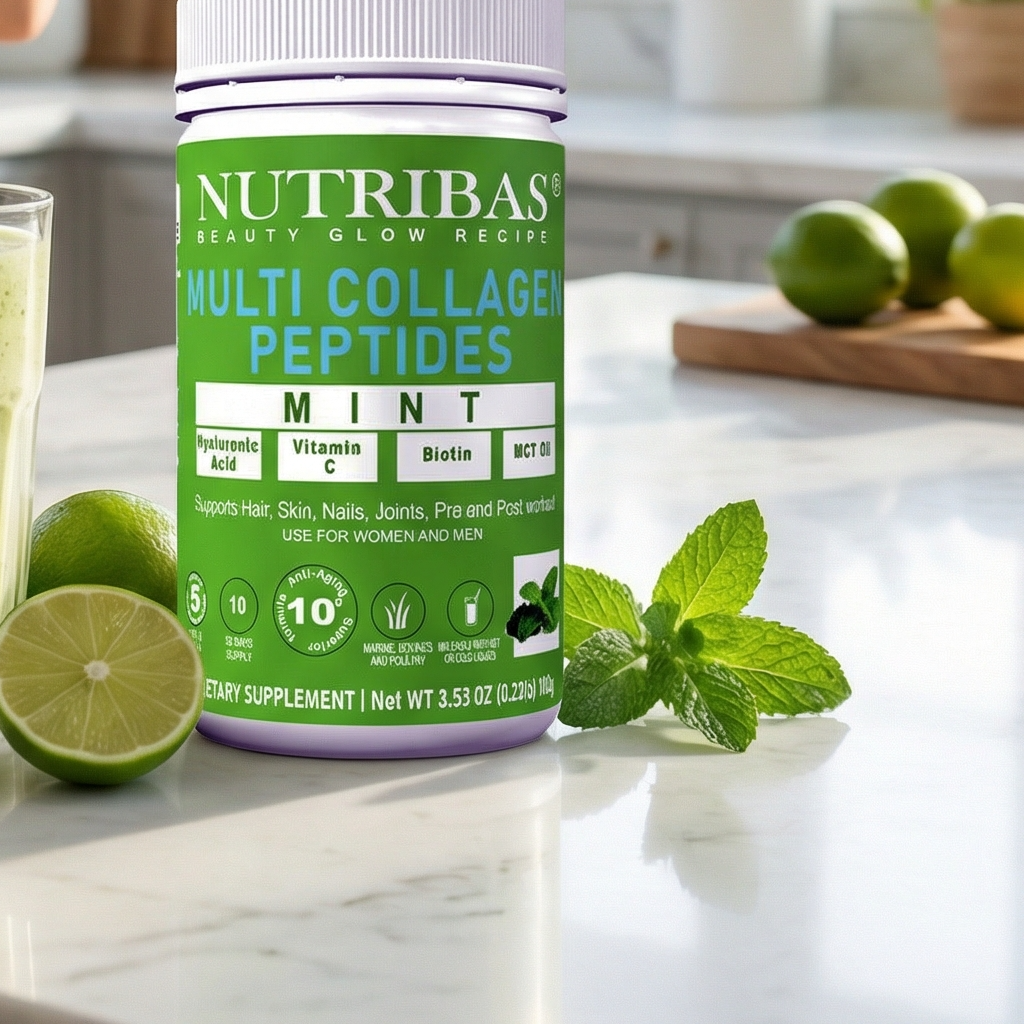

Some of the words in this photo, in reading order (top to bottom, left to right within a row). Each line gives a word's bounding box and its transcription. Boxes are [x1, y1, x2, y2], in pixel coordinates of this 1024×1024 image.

[197, 228, 300, 244] BEAUTY
[329, 228, 426, 243] GLOW
[456, 228, 547, 244] RECIPE
[187, 268, 301, 317] MULTI
[327, 267, 562, 318] COLLAGEN
[250, 325, 512, 375] PEPTIDES
[284, 391, 480, 424] MINT
[293, 439, 361, 455] Vitamin
[423, 446, 472, 462] Biotin
[514, 442, 537, 459] MCT
[210, 455, 236, 471] Acid
[324, 458, 335, 474] C
[195, 493, 238, 517] Supports
[241, 499, 273, 520] Hair,
[278, 500, 317, 522] Skin,
[322, 502, 369, 522] Nails,
[376, 502, 428, 523] Joints,
[435, 501, 462, 519] Pre
[466, 501, 492, 518] and
[282, 528, 312, 542] USE
[317, 529, 350, 543] FOR
[353, 529, 415, 543] WOMEN
[417, 529, 450, 543] AND
[453, 527, 483, 541] MEN
[190, 583, 200, 613] 5
[229, 594, 247, 615] 10
[204, 678, 241, 703] ETARY
[244, 684, 355, 710] SUPPLEMENT
[371, 690, 402, 711] Net
[407, 690, 434, 709] WT
[438, 687, 470, 709] 3.53
[475, 684, 493, 706] OZ
